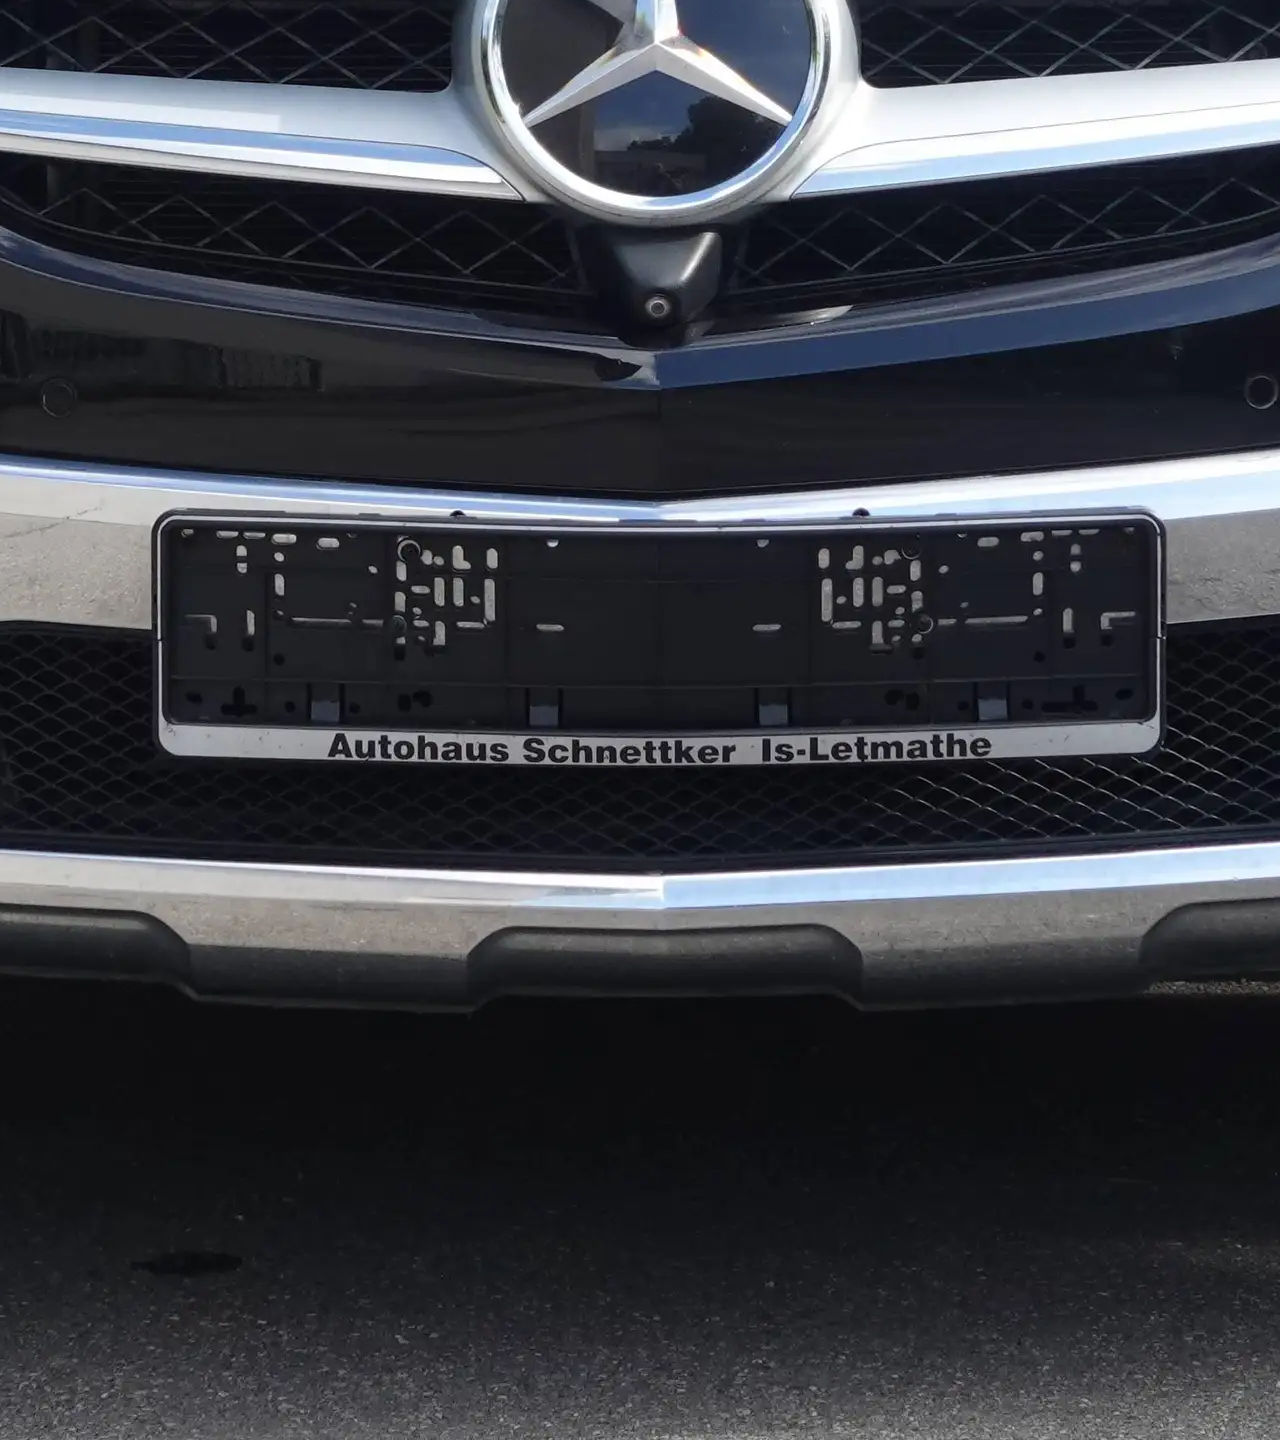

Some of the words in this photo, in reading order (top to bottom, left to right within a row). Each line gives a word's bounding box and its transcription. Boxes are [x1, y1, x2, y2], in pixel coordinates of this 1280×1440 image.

[327, 732, 509, 762] Autohaus
[522, 737, 736, 764] Schnettker
[761, 733, 993, 763] Is-Letmathe
